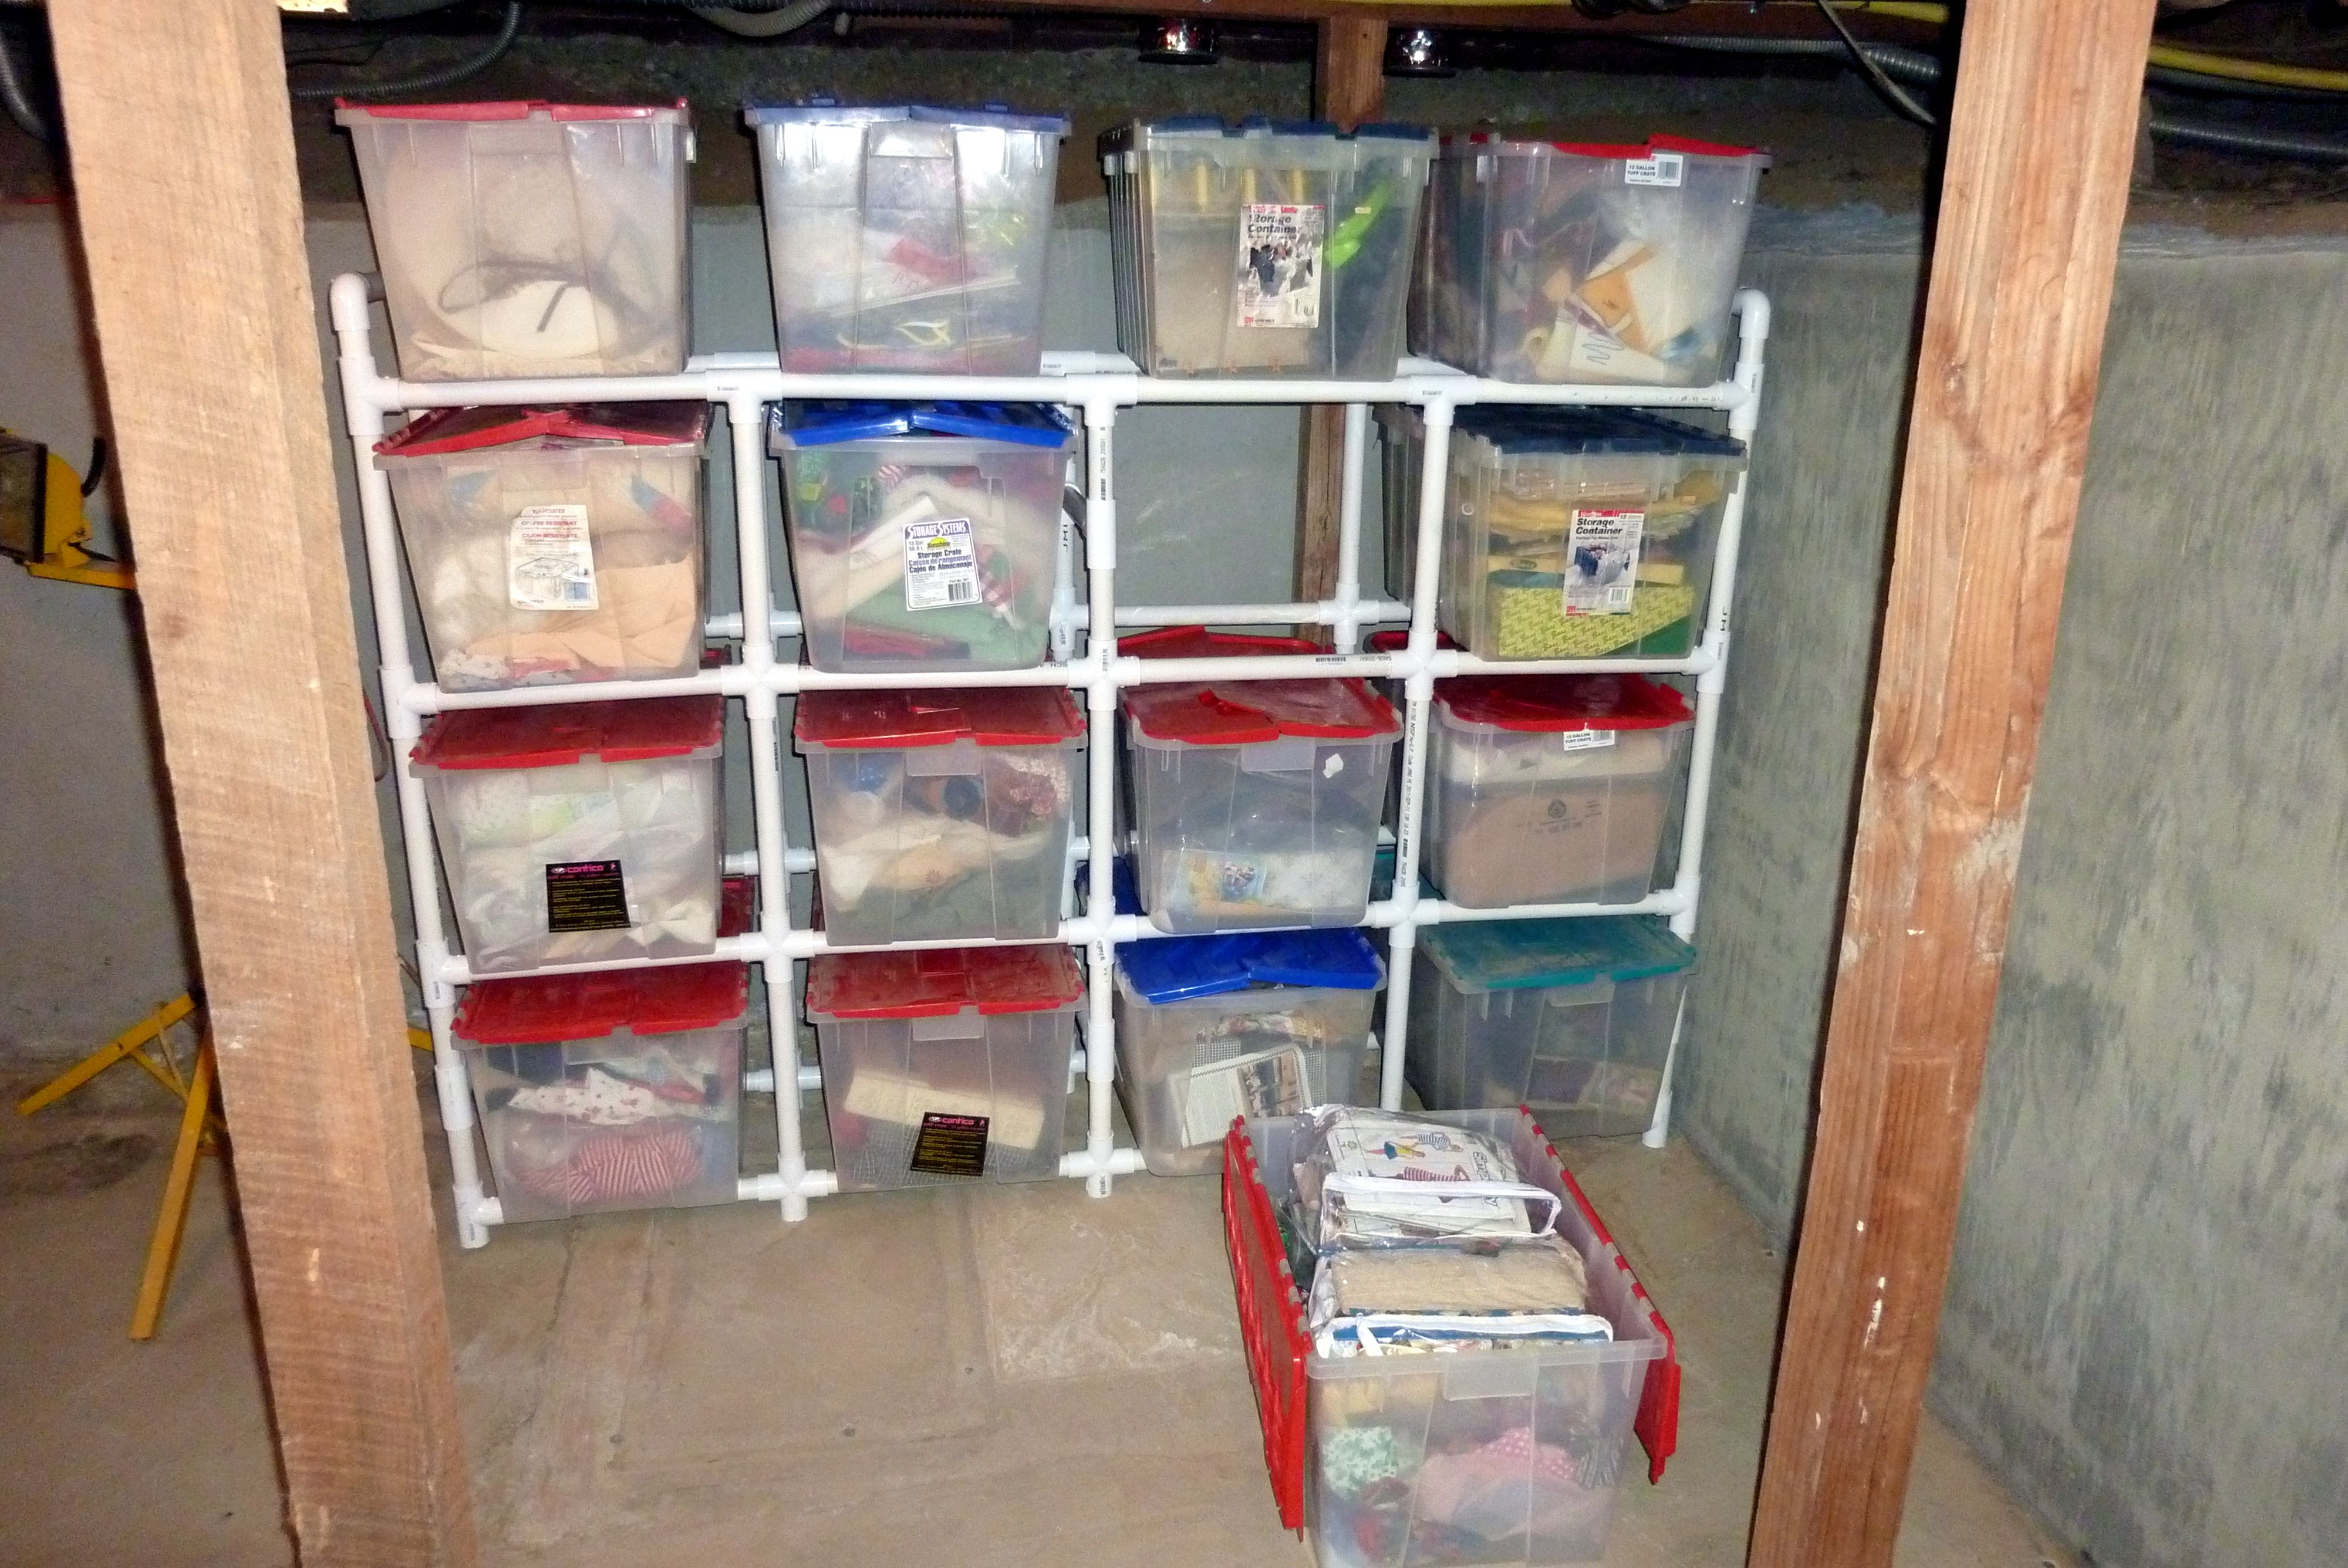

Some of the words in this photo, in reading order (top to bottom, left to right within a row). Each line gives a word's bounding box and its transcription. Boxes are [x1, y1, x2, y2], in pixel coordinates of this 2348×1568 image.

[1248, 224, 1298, 234] Containe
[1577, 518, 1614, 526] Storage
[1576, 526, 1622, 535] Container
[917, 550, 943, 559] Storage
